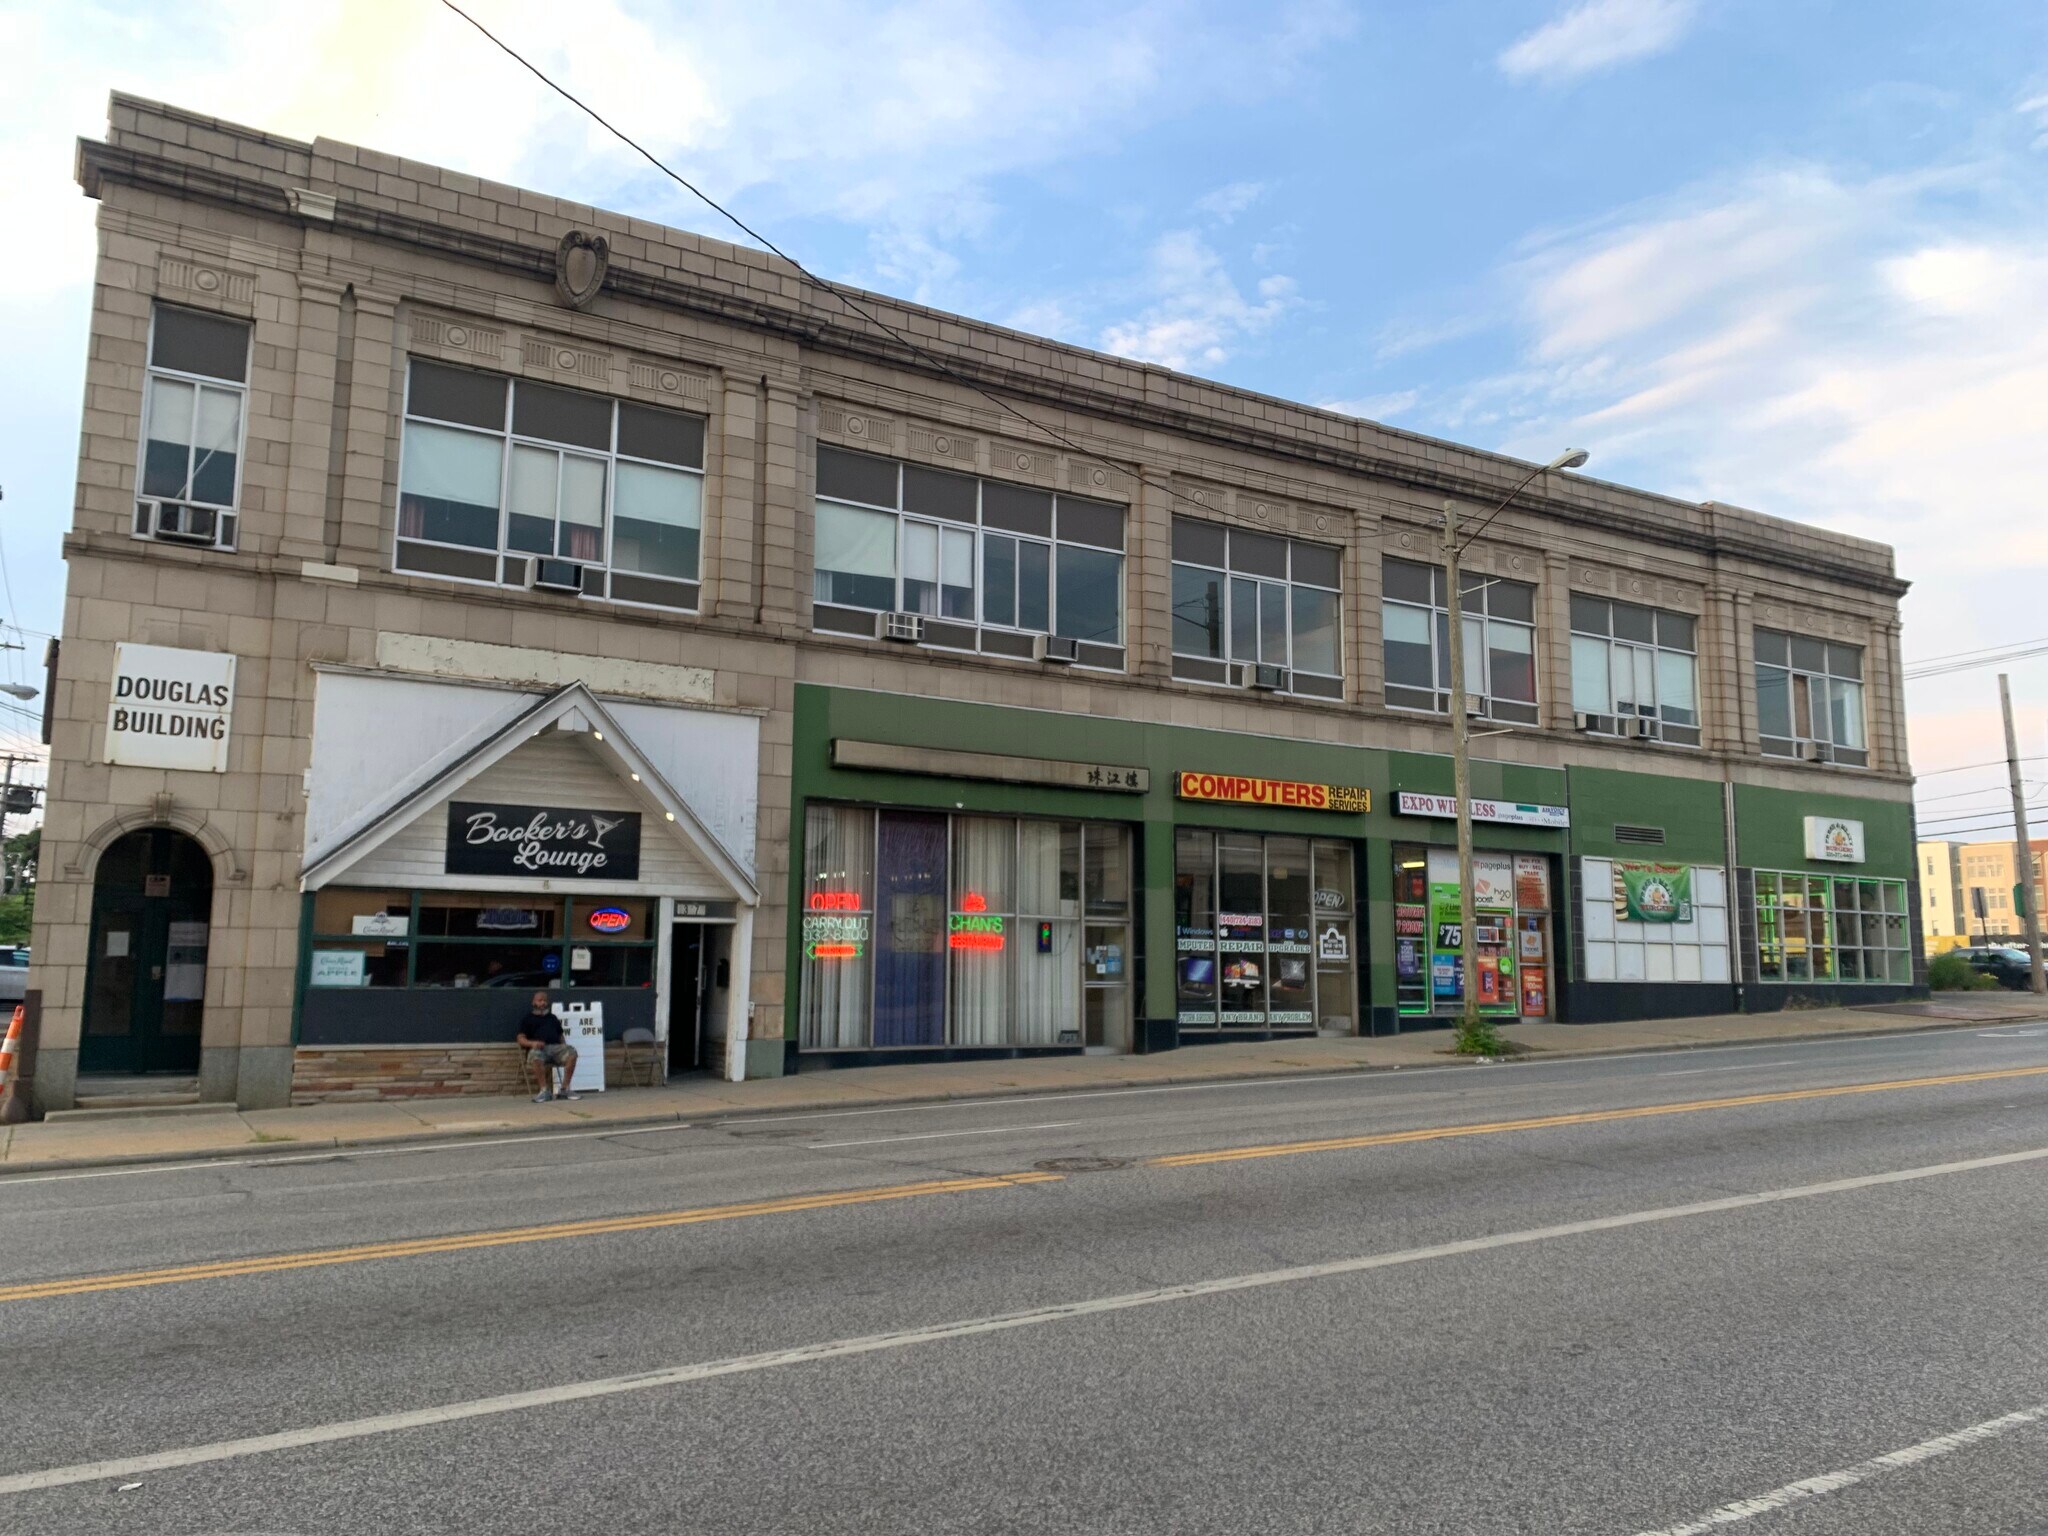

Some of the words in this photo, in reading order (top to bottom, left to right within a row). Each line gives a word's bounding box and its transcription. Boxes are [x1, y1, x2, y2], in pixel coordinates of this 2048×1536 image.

[115, 676, 228, 707] DOUGLAS
[113, 709, 225, 740] BUILDING
[1182, 774, 1326, 807] COMPUTERS
[1328, 786, 1367, 801] REPAIR
[1328, 799, 1368, 812] SERVICES
[1402, 795, 1434, 812] EXPO
[1436, 798, 1496, 818] WILESS
[466, 812, 589, 845] Booker's
[513, 841, 608, 875] Lounge
[1480, 861, 1511, 871] pageplus
[810, 892, 860, 911] OPEN
[589, 913, 627, 928] OPEN
[1182, 928, 1214, 936] Windows
[1440, 925, 1462, 946] $75
[1220, 943, 1264, 951] REPAIR
[579, 1018, 593, 1026] ARE
[582, 1027, 602, 1035] OPEN
